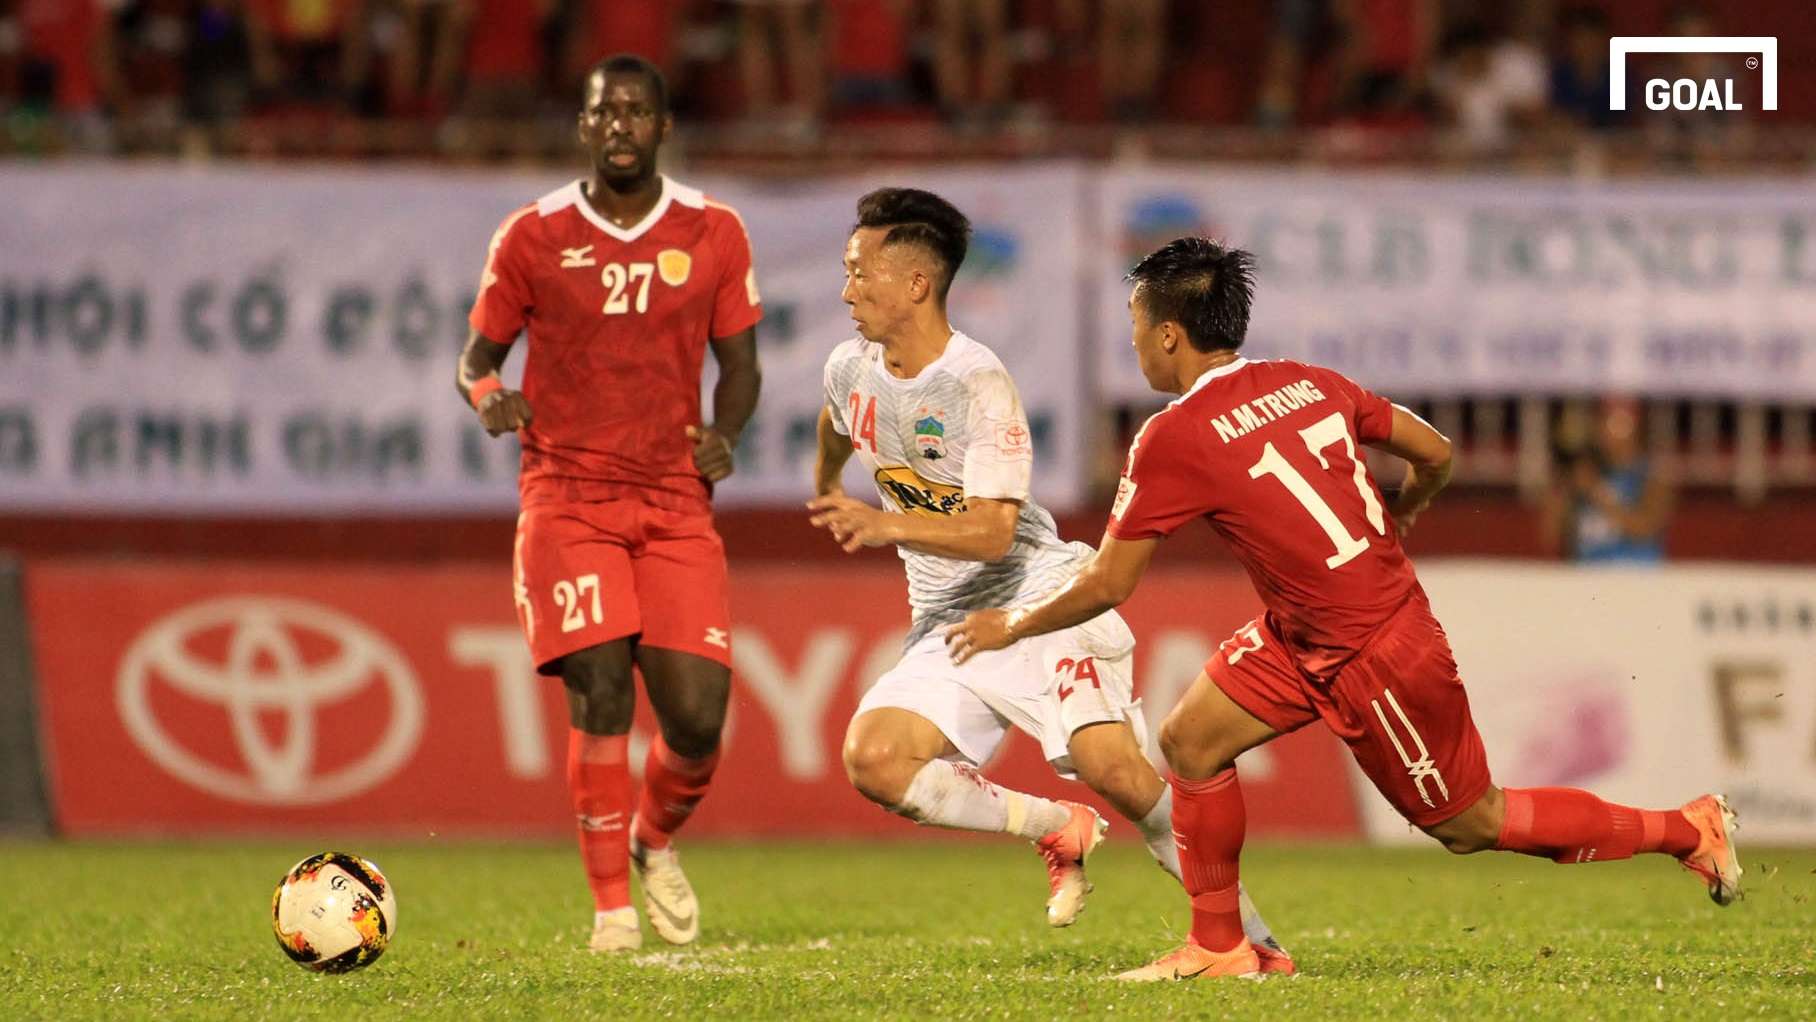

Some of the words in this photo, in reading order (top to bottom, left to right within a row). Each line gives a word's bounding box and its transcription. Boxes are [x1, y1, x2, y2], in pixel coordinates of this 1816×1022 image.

[601, 262, 654, 315] 27
[849, 392, 877, 454] 24
[1211, 378, 1326, 444] N.M.TRUNG
[1248, 411, 1386, 570] 17
[553, 573, 603, 633] 27
[1055, 656, 1101, 702] 24
